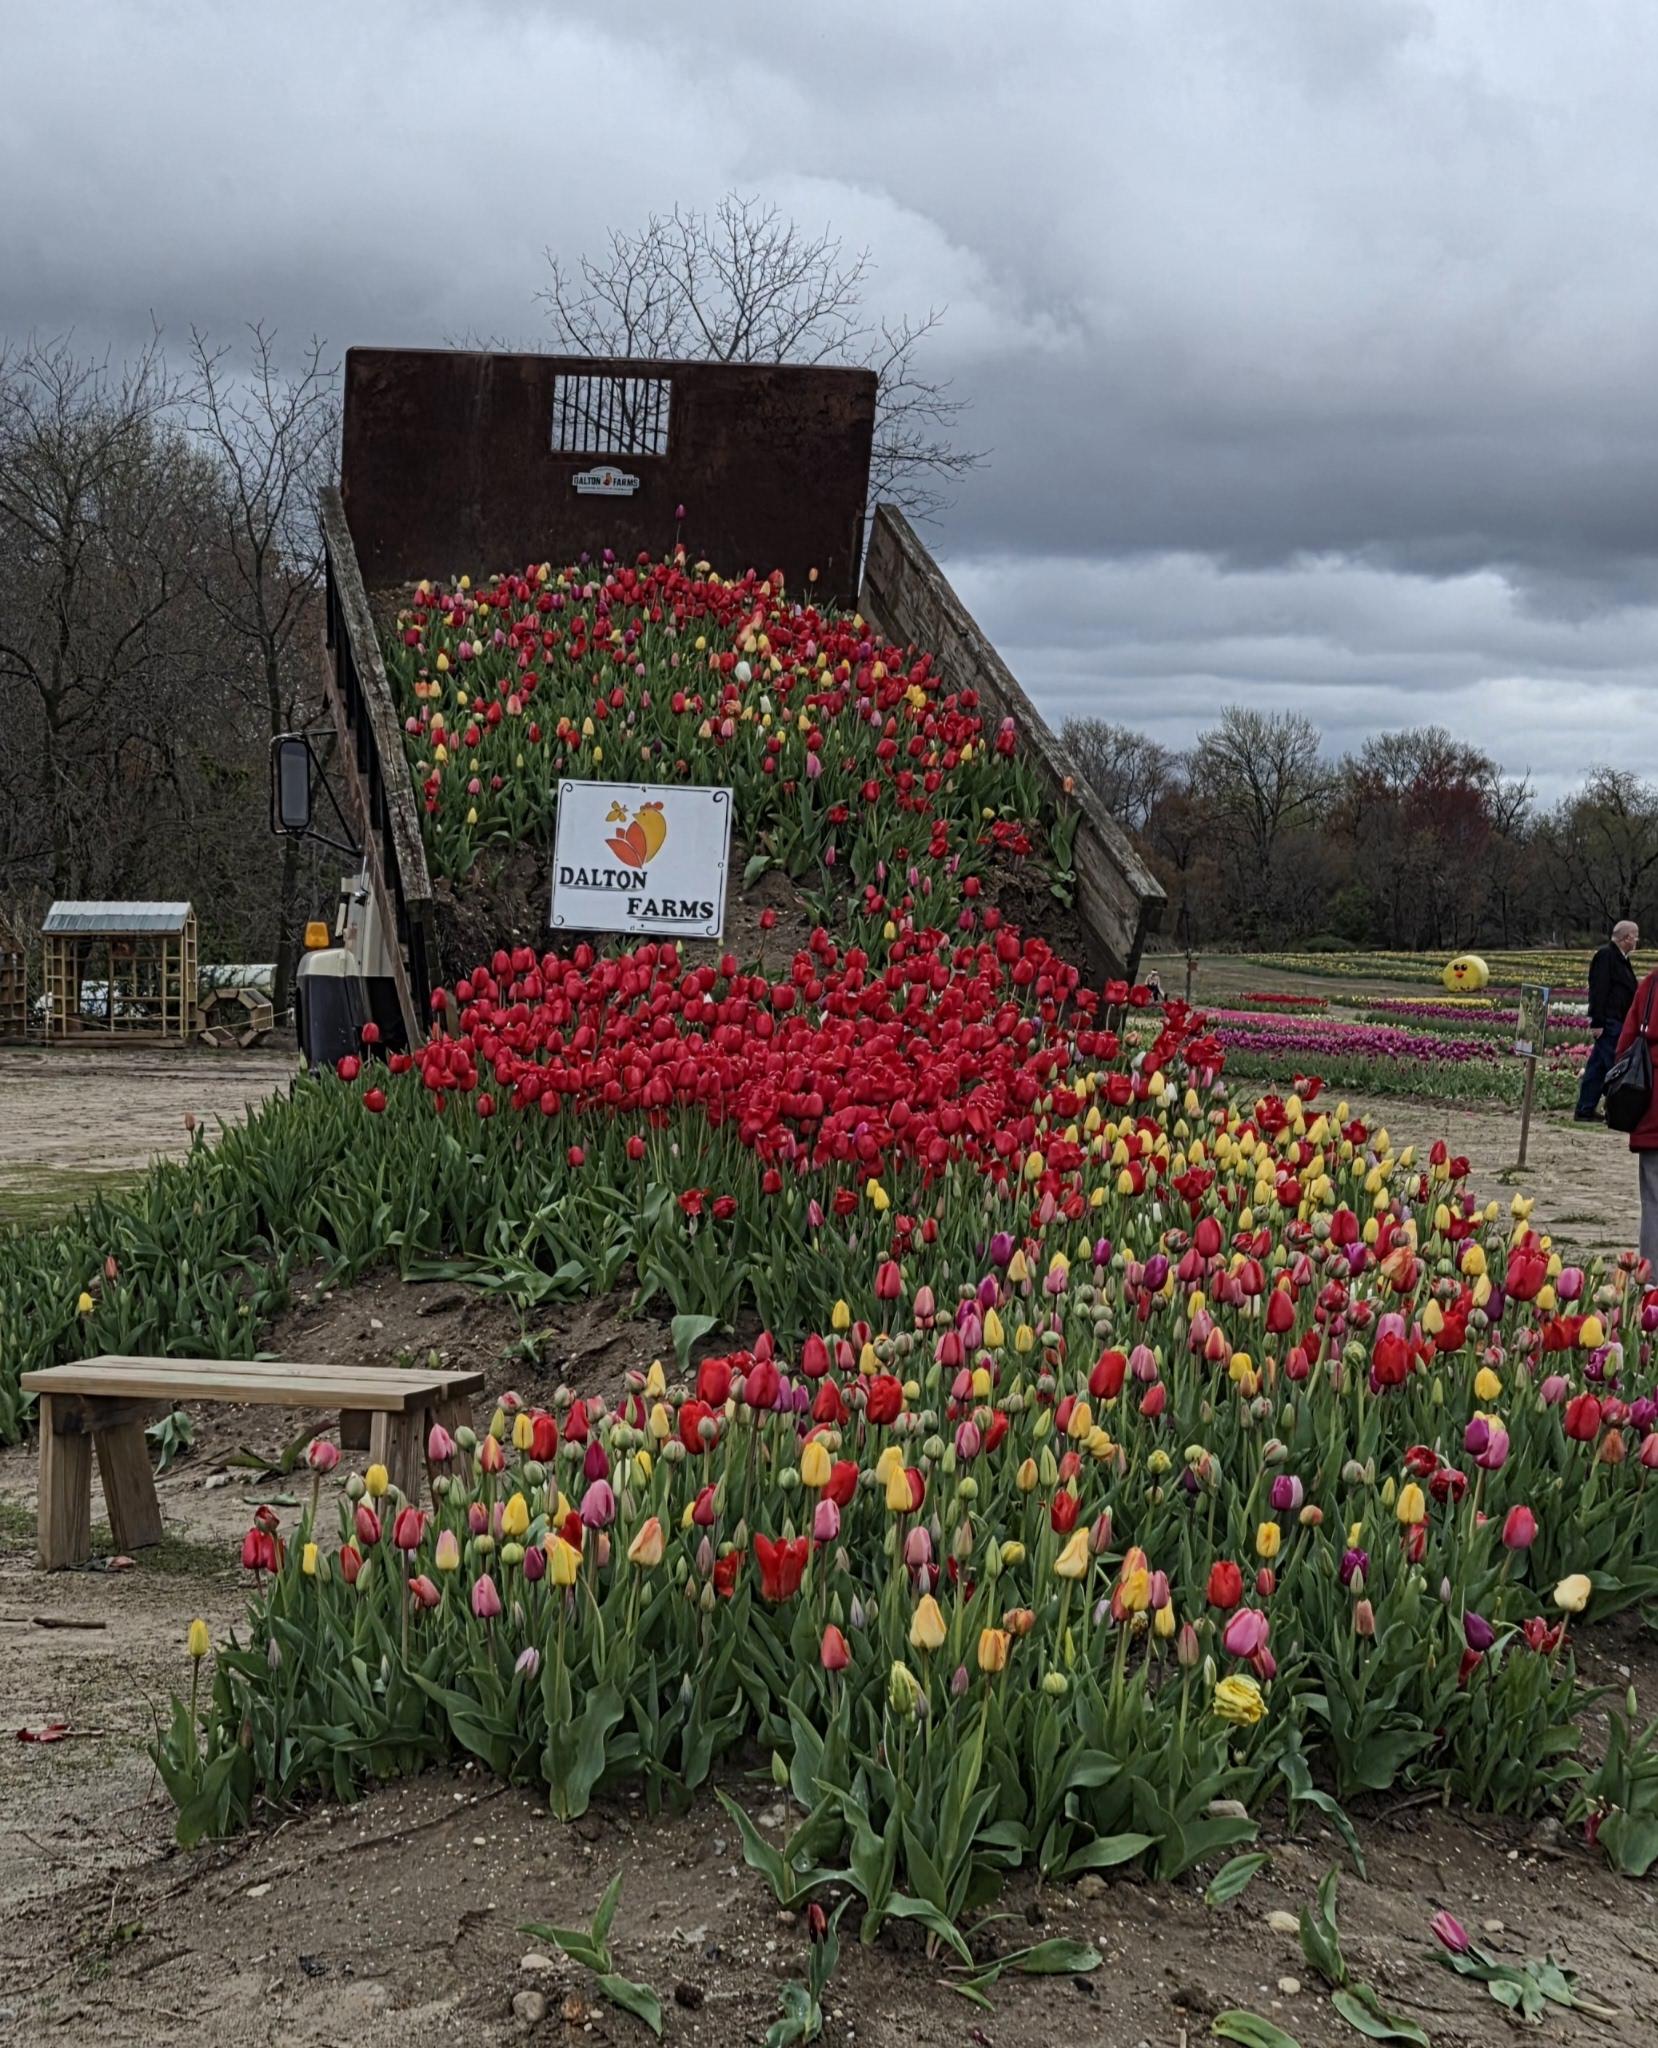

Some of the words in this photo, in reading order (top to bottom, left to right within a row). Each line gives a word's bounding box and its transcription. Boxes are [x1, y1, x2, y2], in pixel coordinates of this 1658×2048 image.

[574, 476, 601, 486] DALTON
[613, 478, 639, 487] FARMS
[559, 866, 648, 890] DALTON
[626, 897, 714, 919] FARMS
